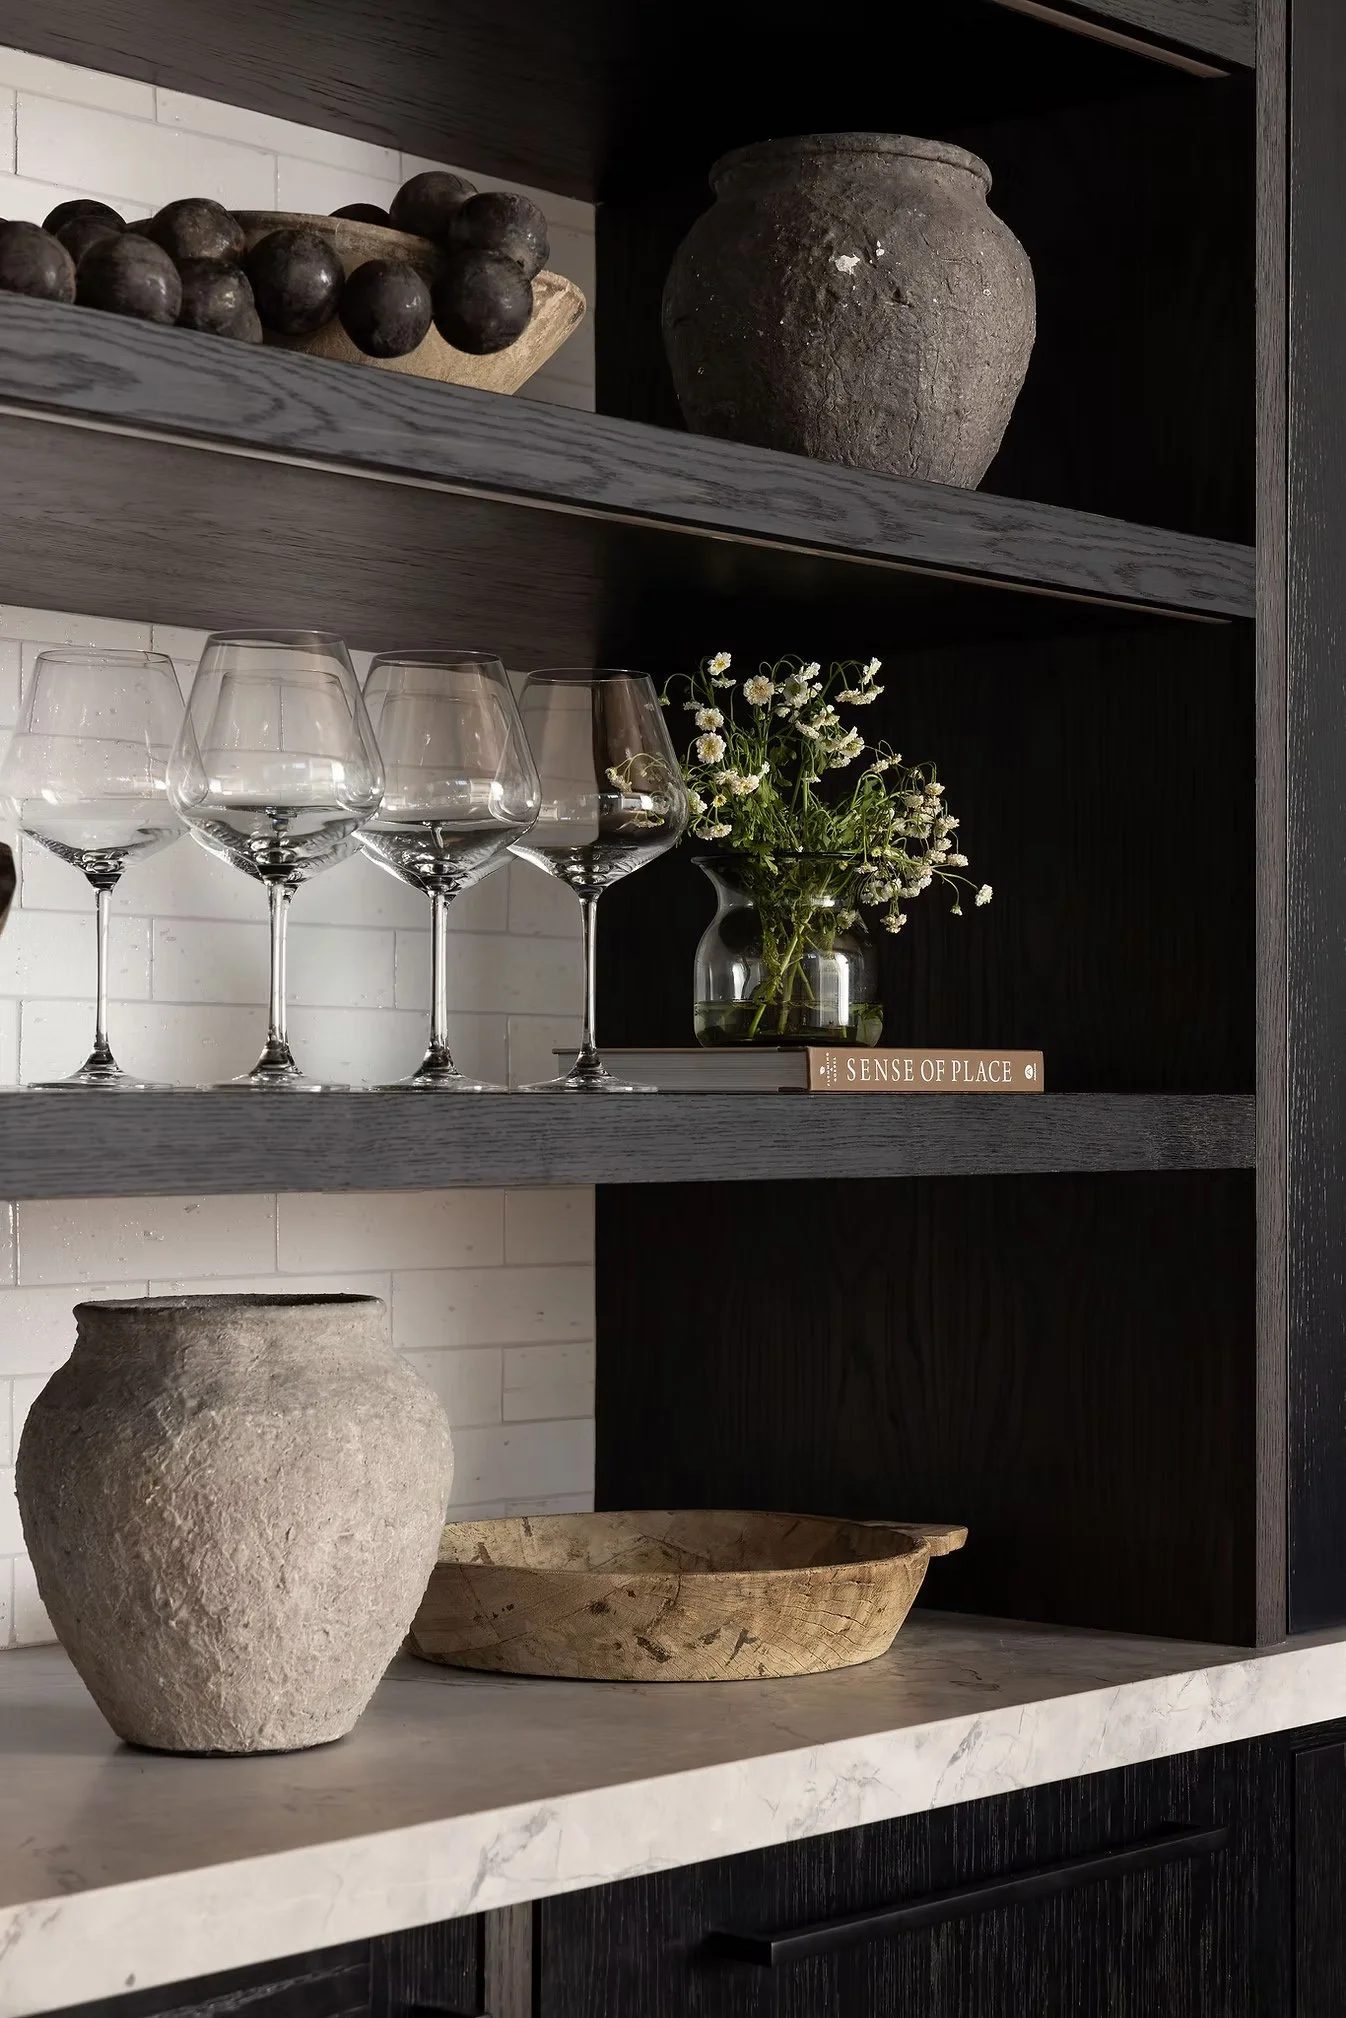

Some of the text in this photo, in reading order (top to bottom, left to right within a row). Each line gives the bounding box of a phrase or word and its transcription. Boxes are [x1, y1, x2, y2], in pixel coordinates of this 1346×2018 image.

[846, 1057, 914, 1082] SENSE
[920, 1058, 945, 1082] OF
[951, 1059, 1012, 1083] PLACE
